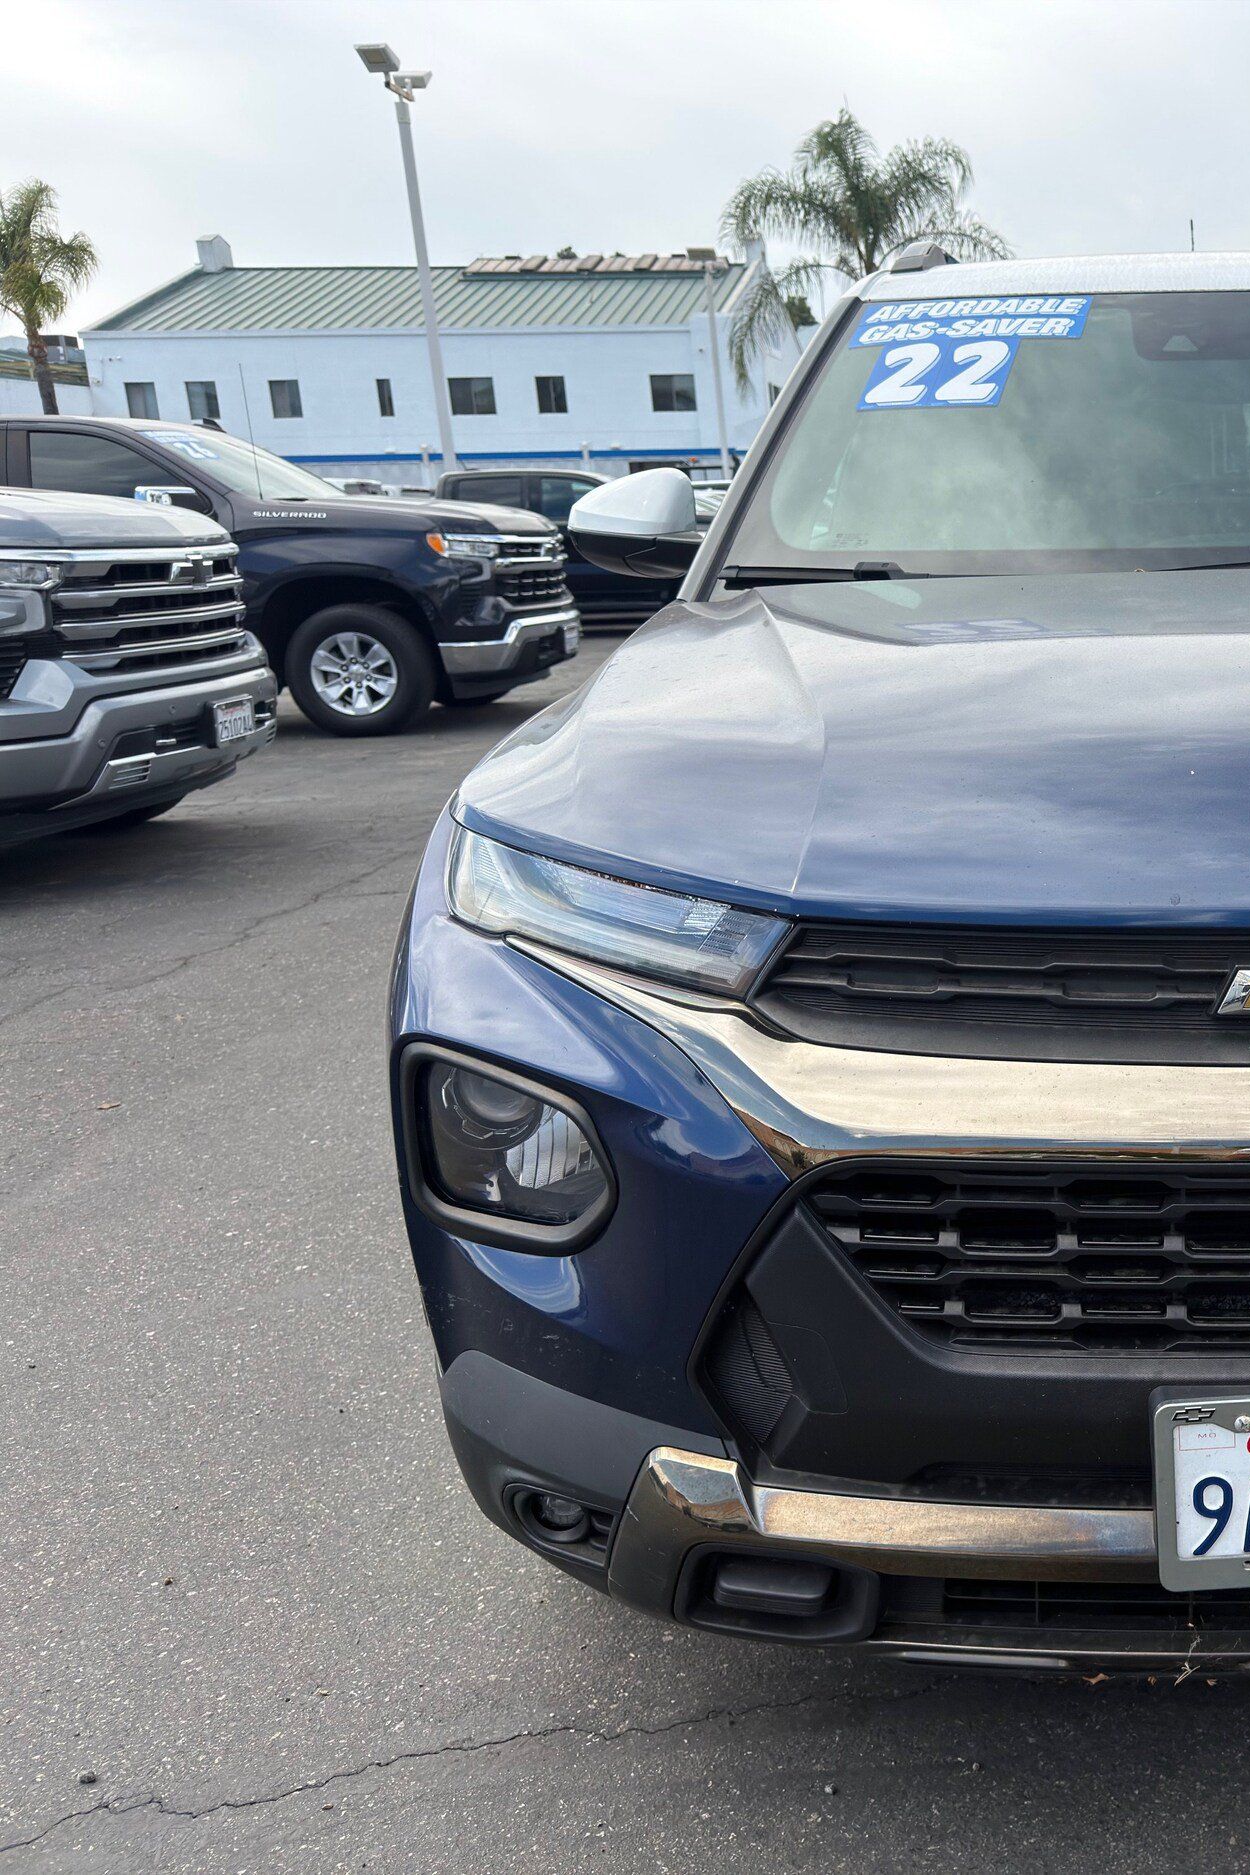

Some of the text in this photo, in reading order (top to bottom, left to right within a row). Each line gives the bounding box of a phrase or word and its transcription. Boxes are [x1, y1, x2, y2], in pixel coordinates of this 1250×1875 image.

[865, 298, 1088, 324] AFFORDABLE
[860, 317, 1073, 343] GAS-SAVER
[864, 340, 1011, 407] 22
[252, 510, 327, 519] SILVERADO
